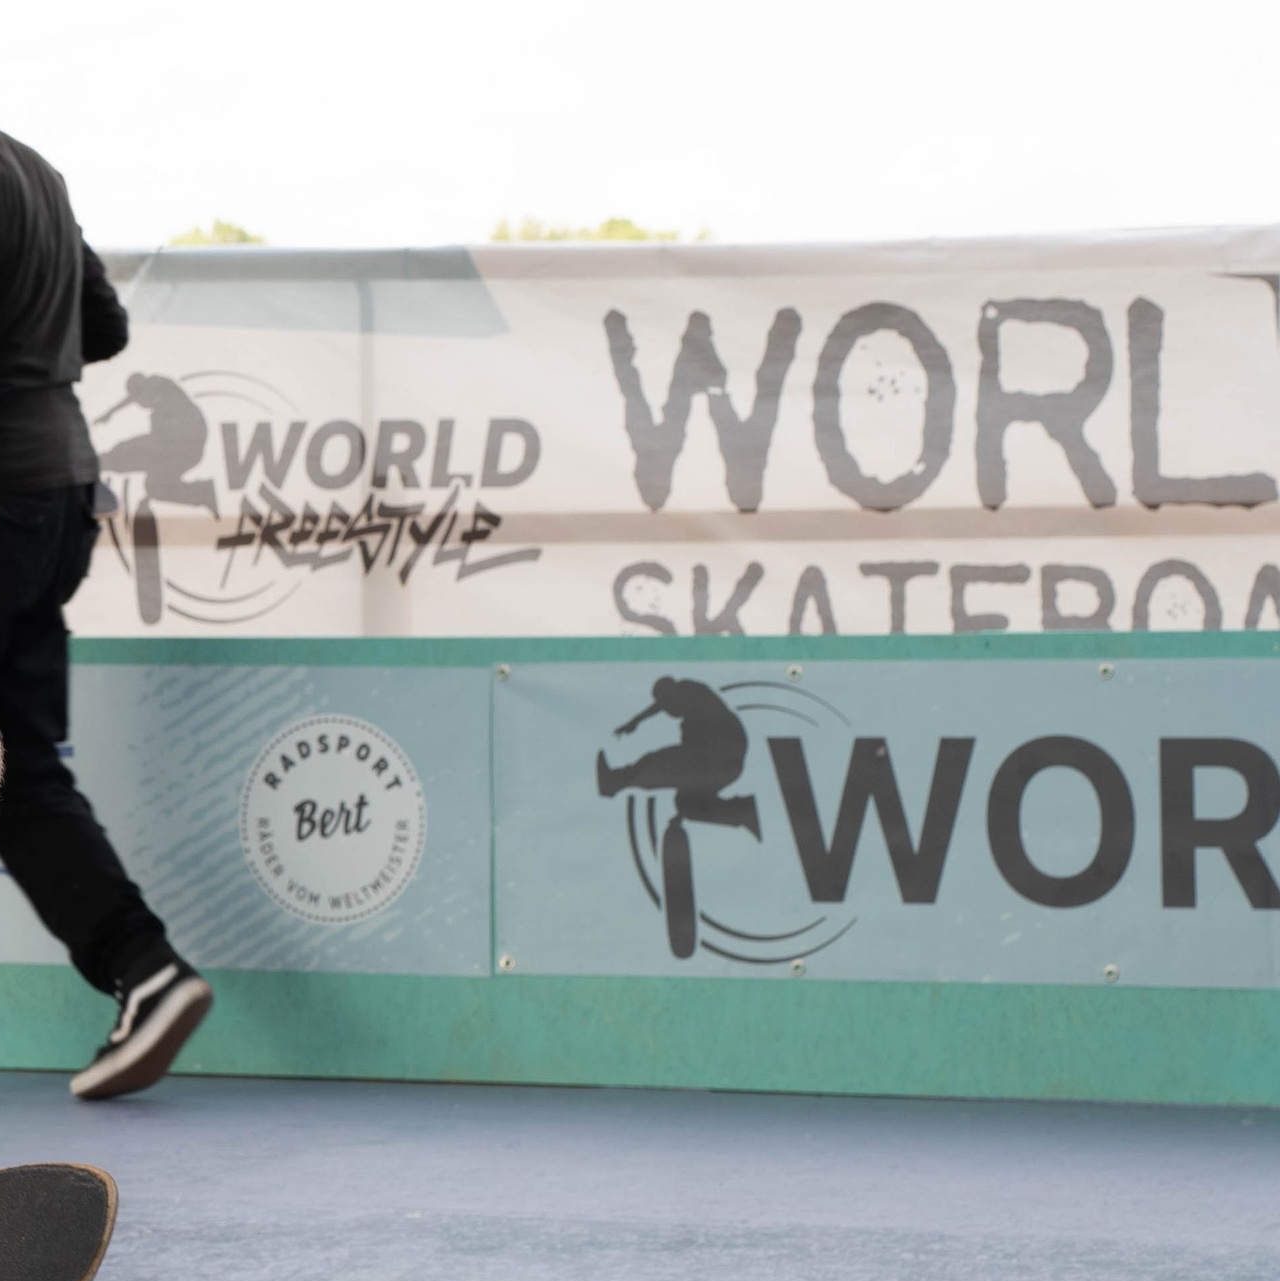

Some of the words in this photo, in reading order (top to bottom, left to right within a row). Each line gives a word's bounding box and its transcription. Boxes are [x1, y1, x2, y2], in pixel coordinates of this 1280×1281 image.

[220, 417, 542, 490] WORLD
[216, 482, 544, 587] FREESTYLE
[263, 733, 404, 791] RADSPORT
[293, 793, 373, 843] Bert
[766, 733, 1280, 911] WOR
[286, 877, 322, 908] VOM
[328, 818, 412, 911] WELTMEISTER
